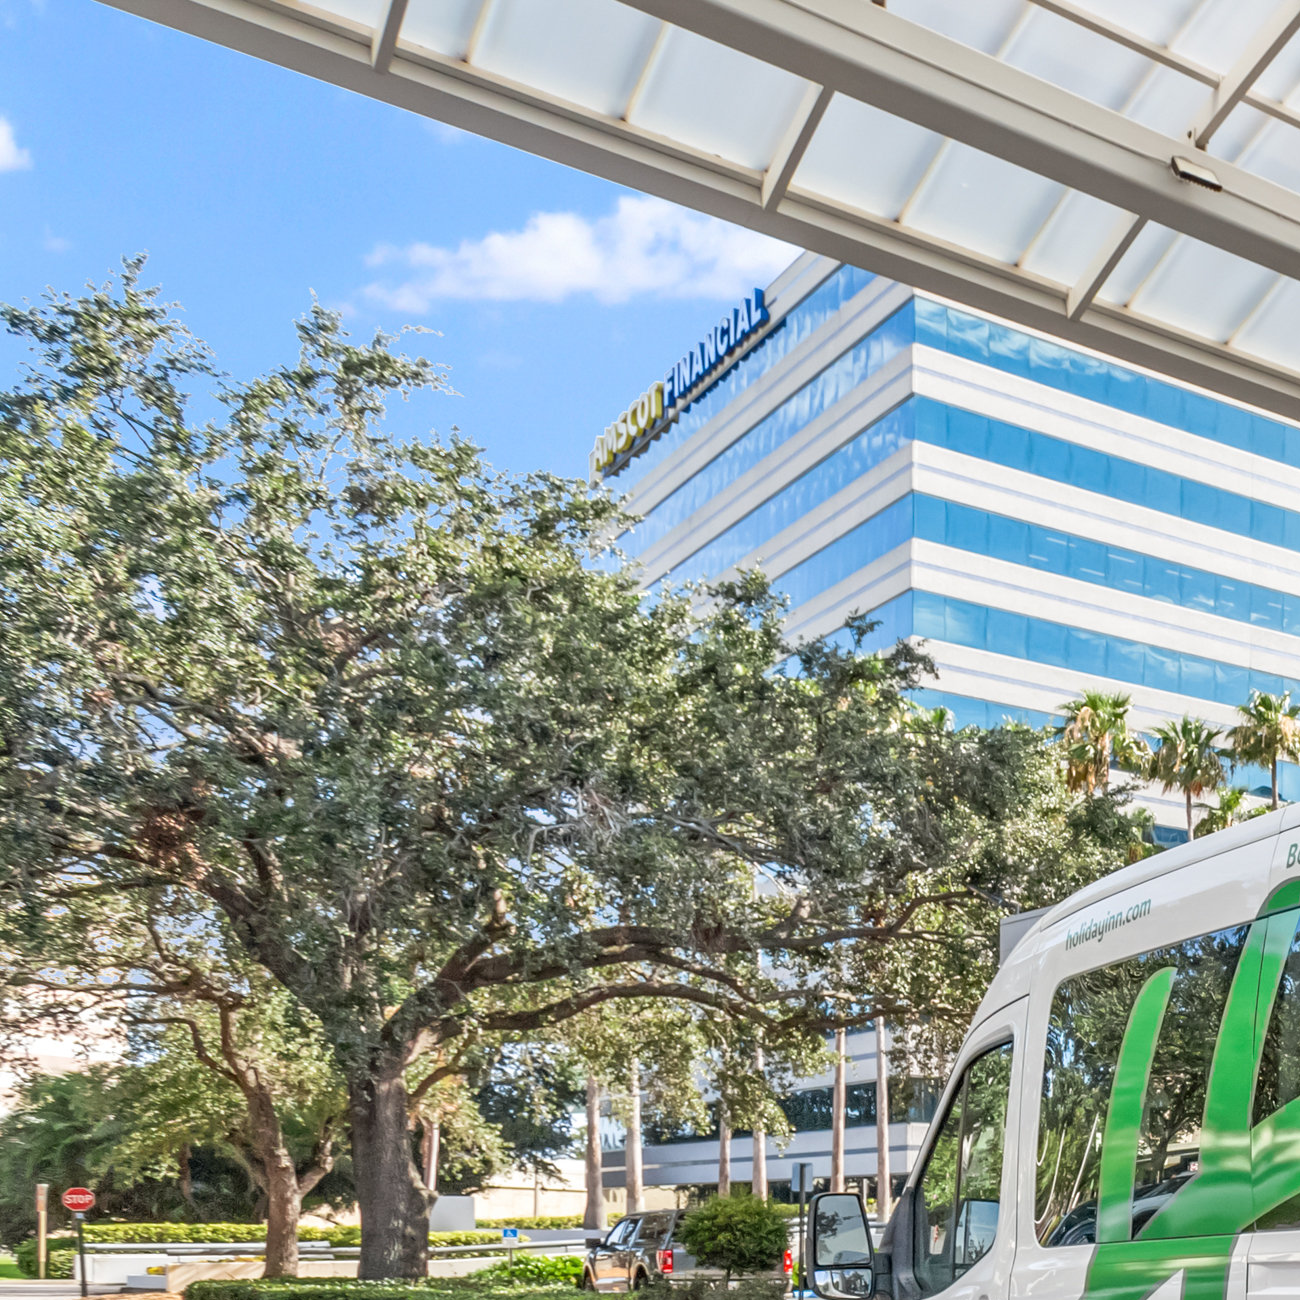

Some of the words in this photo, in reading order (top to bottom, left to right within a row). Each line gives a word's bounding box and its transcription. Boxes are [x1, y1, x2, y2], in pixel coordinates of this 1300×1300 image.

[593, 381, 664, 473] AMSCOT
[663, 288, 769, 408] FINANCIAL
[1065, 898, 1152, 951] holidayinn.com
[64, 1194, 94, 1204] STOP
